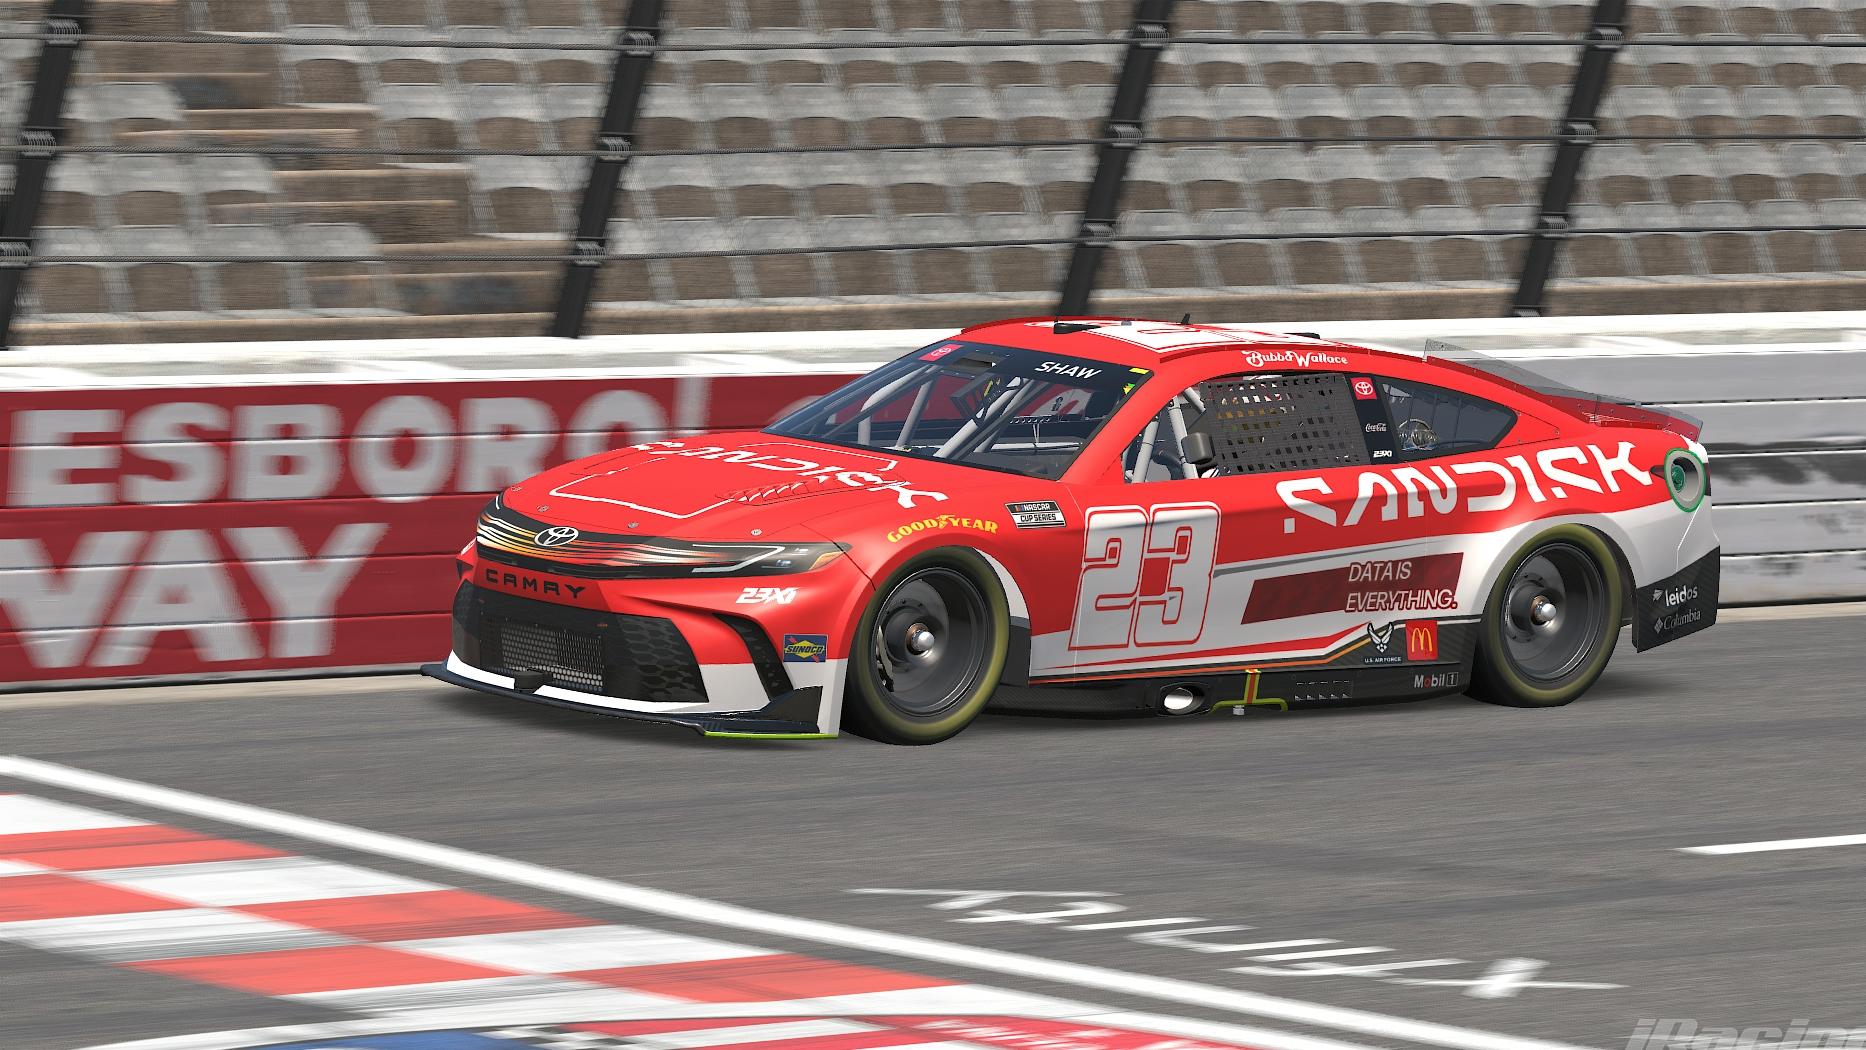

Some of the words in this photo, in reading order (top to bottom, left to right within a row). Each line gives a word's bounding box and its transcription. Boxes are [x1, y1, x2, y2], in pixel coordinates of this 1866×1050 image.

[1284, 350, 1349, 367] Wallace
[1035, 361, 1102, 379] SHAW
[1276, 441, 1652, 534] SANDISK
[1023, 503, 1050, 511] NASCAR
[1033, 513, 1057, 521] SERIES
[887, 514, 999, 543] GOODYEAR
[1068, 501, 1222, 651] 23
[1348, 561, 1393, 582] DATA
[1395, 561, 1412, 580] IS
[485, 568, 586, 598] CAMRY
[1345, 588, 1458, 611] EVERYTHING.
[1665, 585, 1698, 607] leidos
[1663, 608, 1701, 630] Columbia
[786, 645, 825, 654] SUNOCO
[1413, 673, 1446, 688] Mobil
